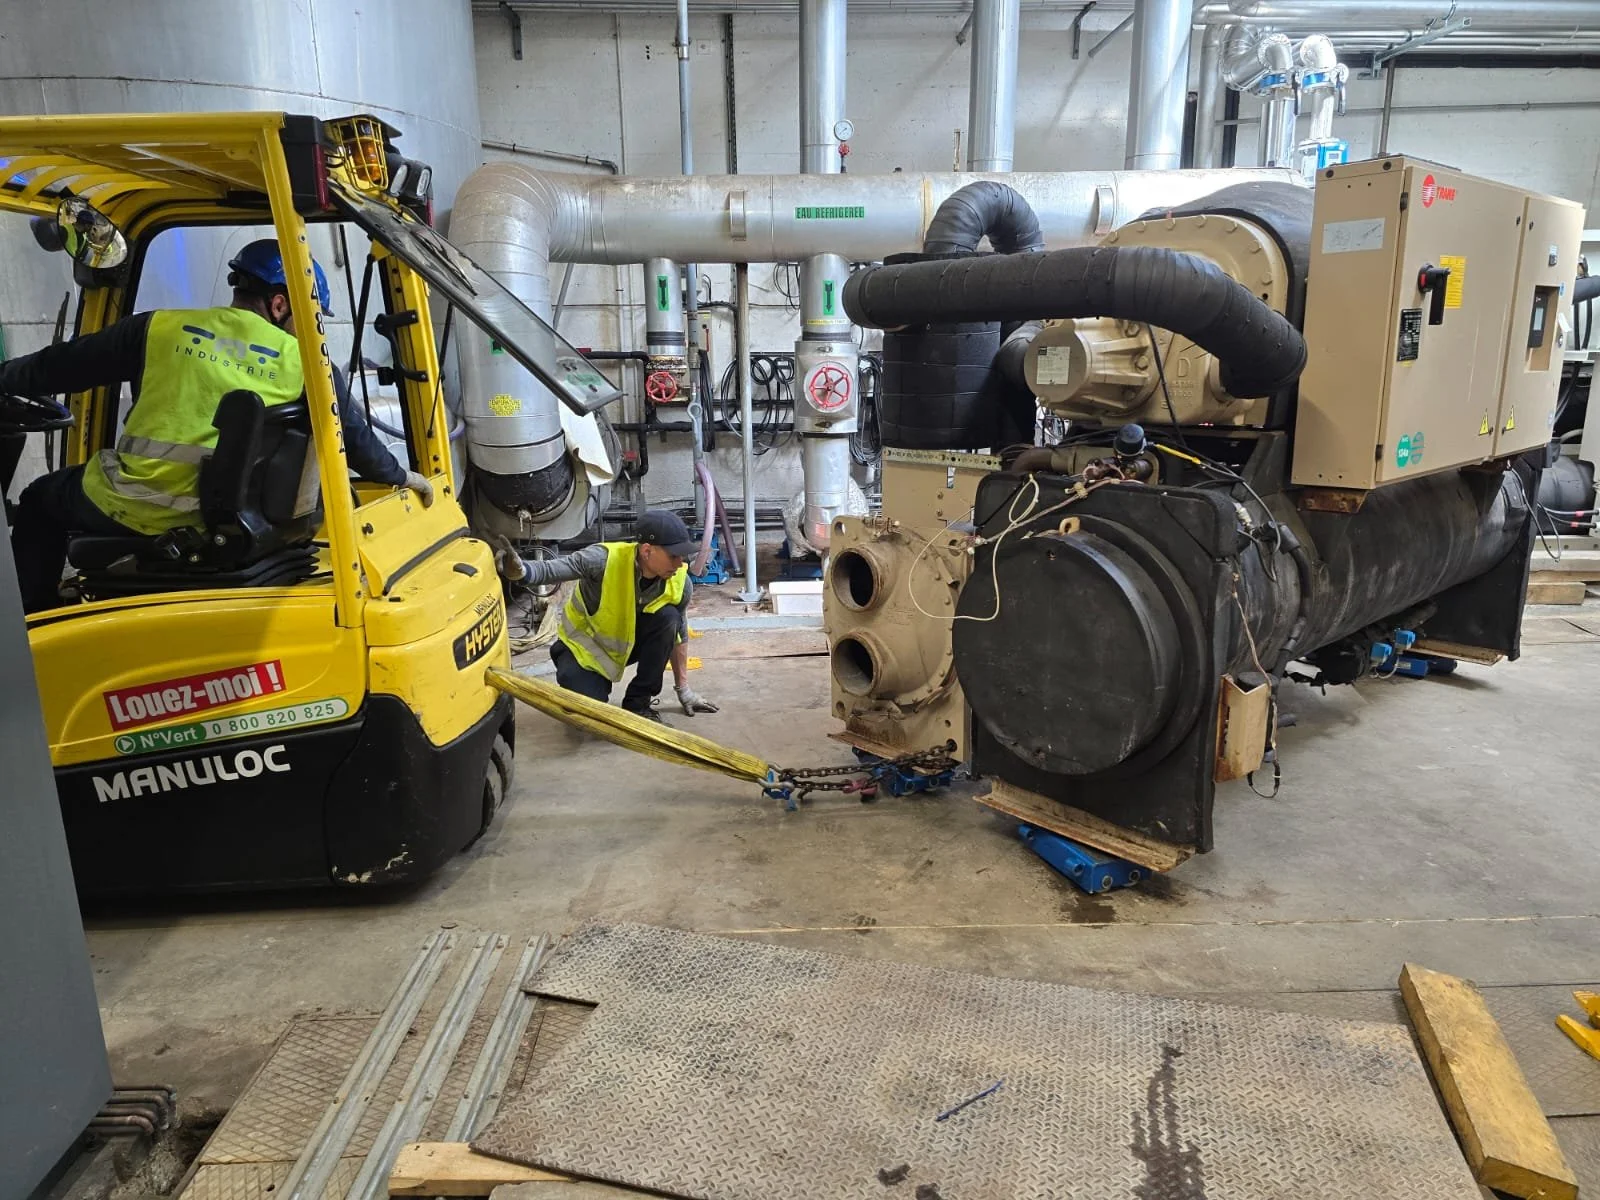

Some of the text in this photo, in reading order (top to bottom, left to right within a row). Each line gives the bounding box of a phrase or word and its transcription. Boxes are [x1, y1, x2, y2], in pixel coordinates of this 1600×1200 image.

[796, 207, 812, 219] EAU
[175, 344, 277, 380] INDUSTRIE
[108, 662, 282, 725] Louez-moi !
[212, 722, 222, 735] 0
[229, 716, 260, 732] 800
[267, 710, 297, 726] 820
[303, 702, 335, 719] 825
[91, 744, 292, 803] MANULOC
